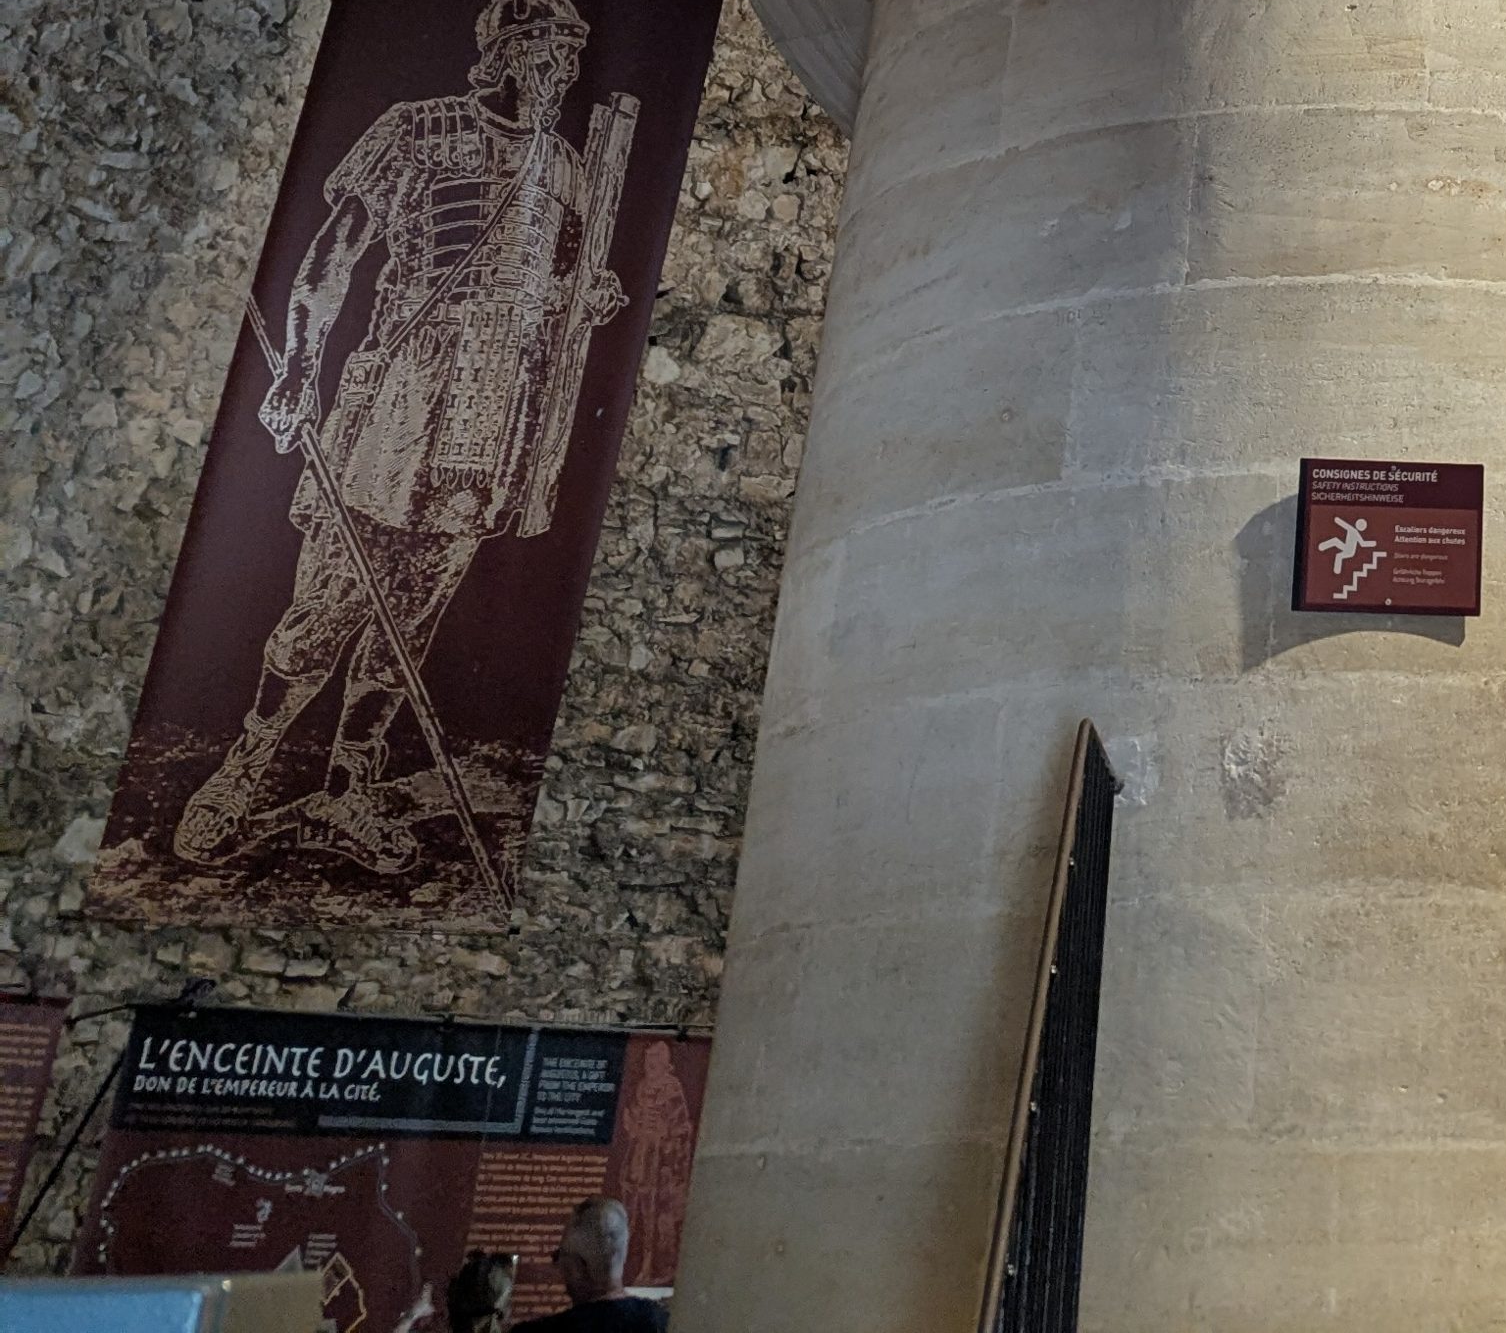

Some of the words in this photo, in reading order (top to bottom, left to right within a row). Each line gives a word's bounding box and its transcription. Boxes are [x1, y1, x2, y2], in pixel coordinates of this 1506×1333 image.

[1312, 468, 1371, 481] CONSIGNES
[1373, 470, 1387, 481] DE
[1388, 469, 1438, 482] SÉCURITÉ
[1312, 481, 1342, 491] SAFETY
[1342, 482, 1399, 492] INSTRUCTIONS
[1311, 492, 1404, 503] SICHERHEITSHINWEISE
[1394, 535, 1428, 544] Attention
[138, 1036, 325, 1078] L'ENCEINTE
[333, 1047, 507, 1089] D'AUGUSTE,
[133, 1075, 172, 1093] DON
[175, 1076, 198, 1095] DE
[201, 1077, 298, 1098] L'EMPEREUR
[318, 1081, 340, 1099] LA
